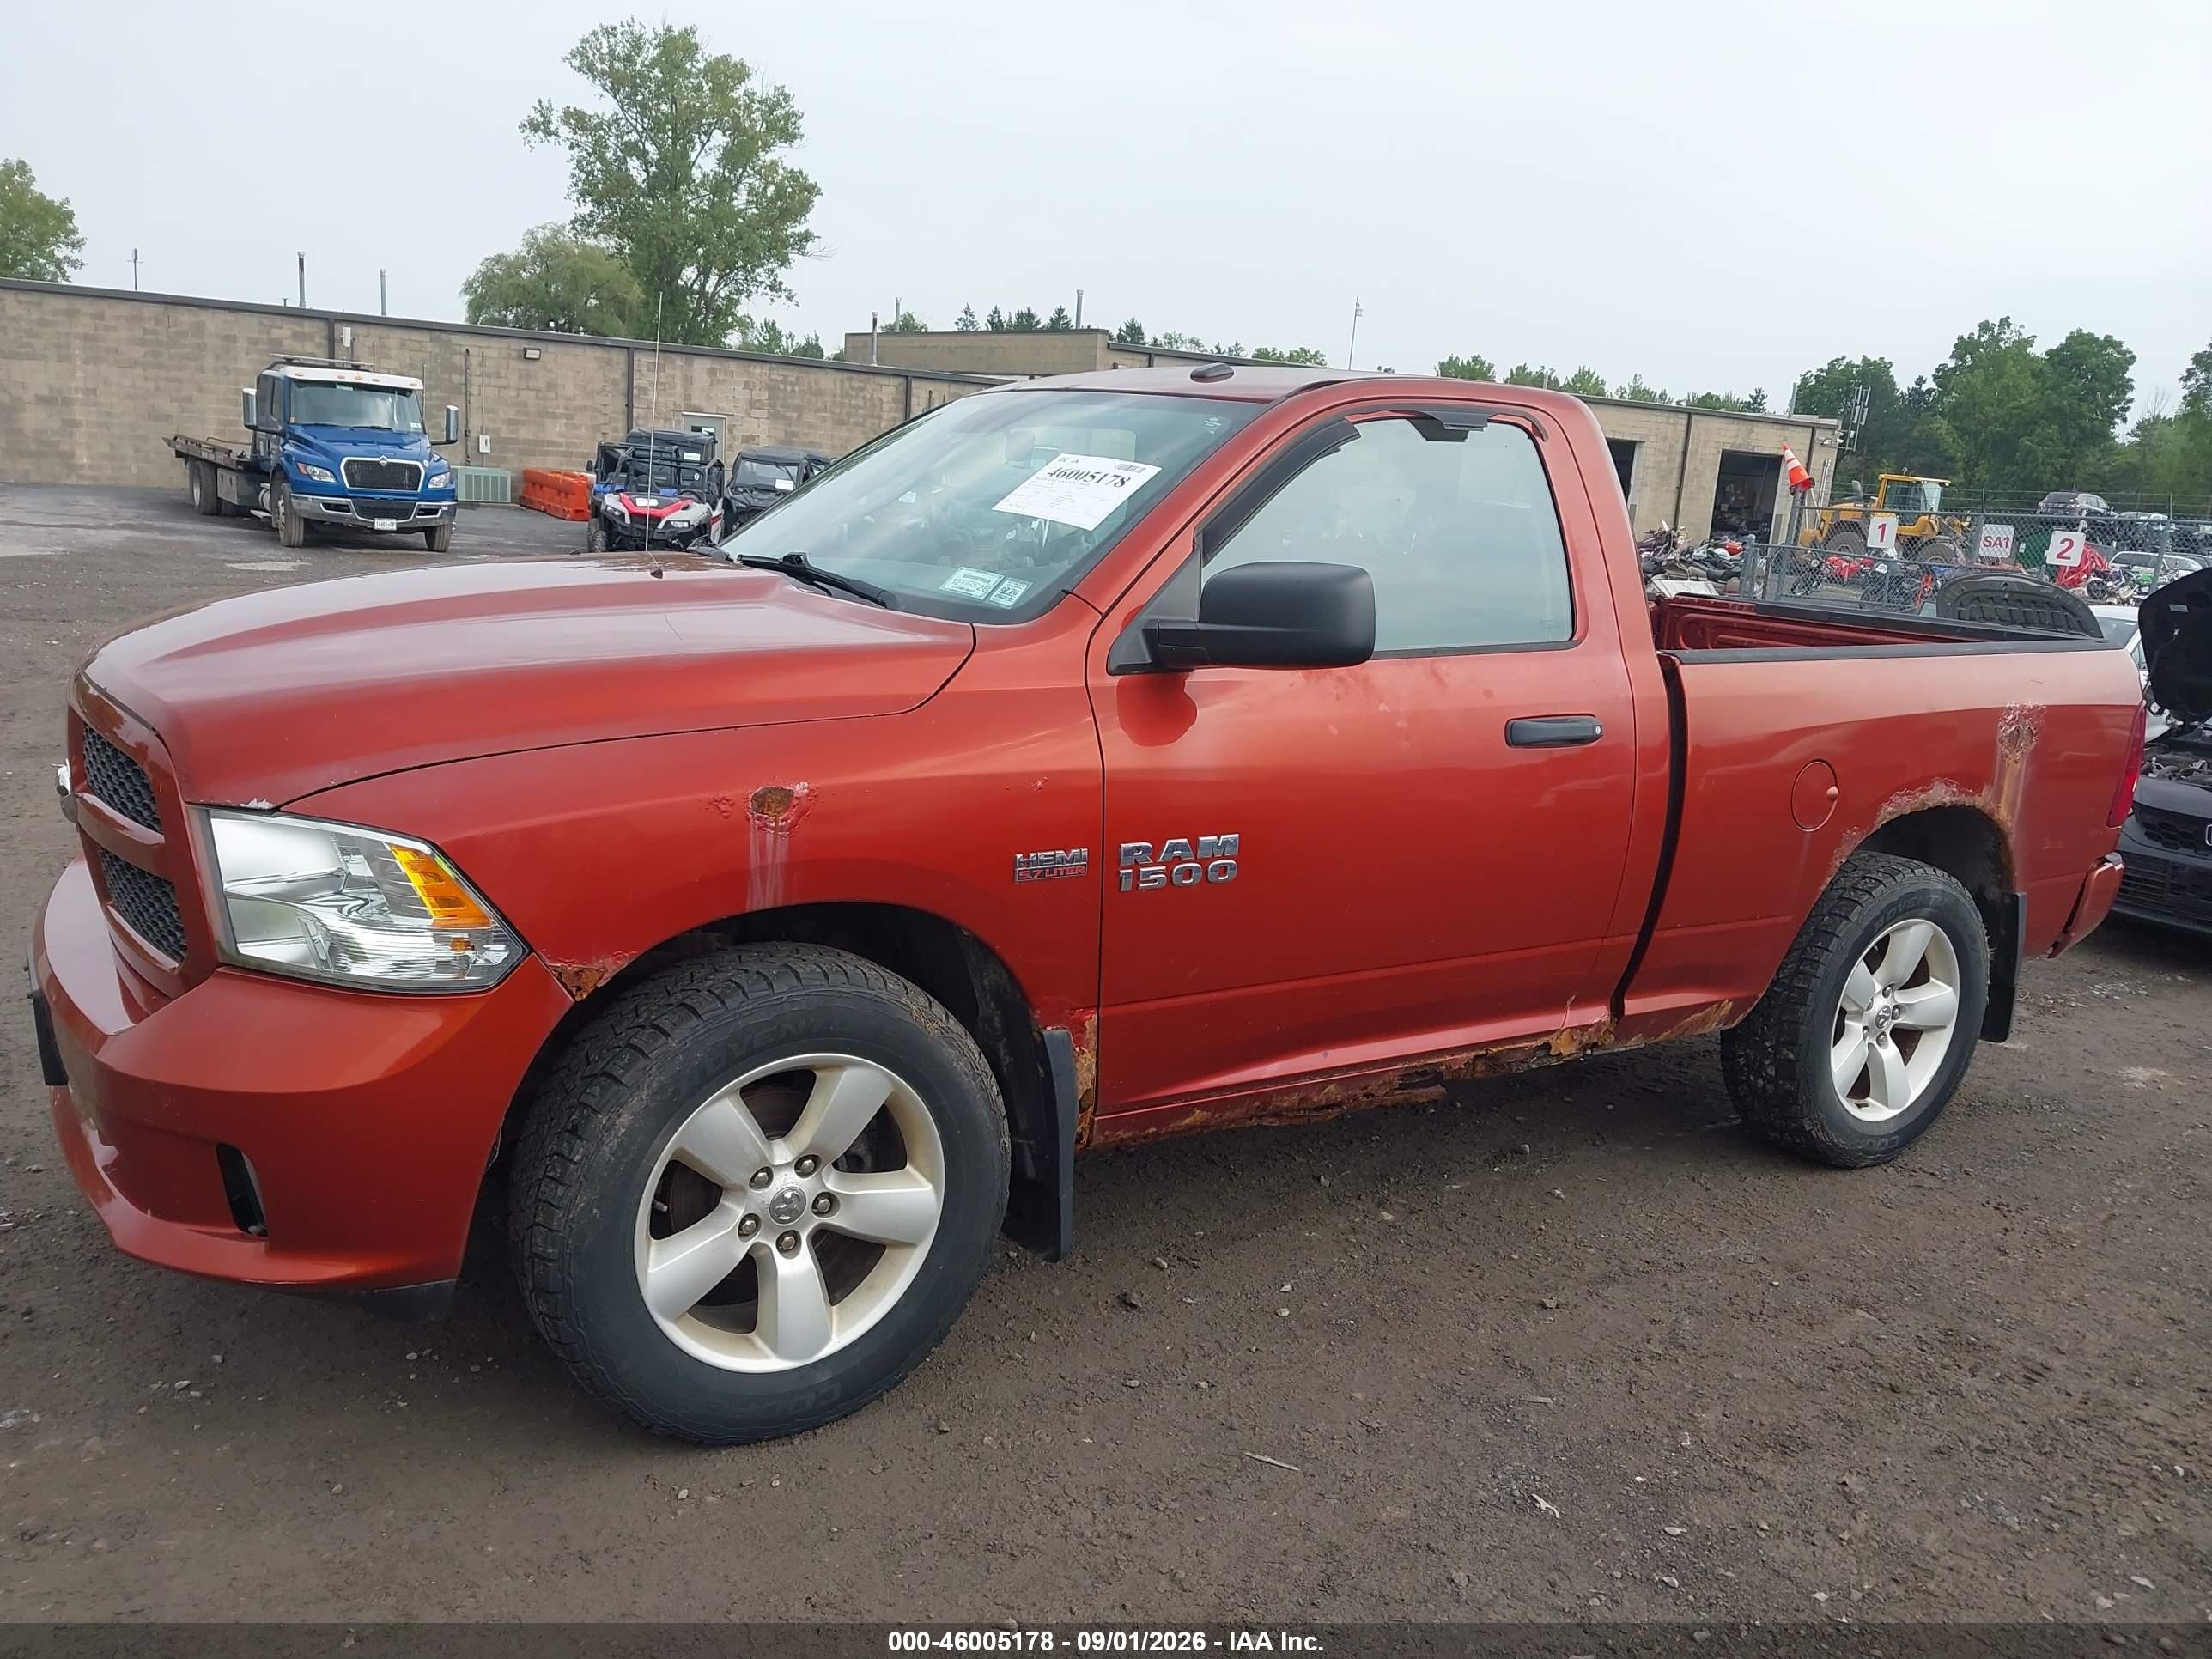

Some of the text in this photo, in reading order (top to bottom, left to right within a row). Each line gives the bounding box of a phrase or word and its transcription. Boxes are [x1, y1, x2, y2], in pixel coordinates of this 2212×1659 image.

[1047, 466, 1131, 488] 46005178
[1877, 522, 1887, 543] 1
[1983, 535, 2010, 550] SA1
[2056, 538, 2075, 561] 2
[1015, 848, 1089, 869] HEMI
[1119, 833, 1241, 866] RAM
[1018, 865, 1086, 880] 5.7 LITER
[1119, 860, 1239, 892] 1500
